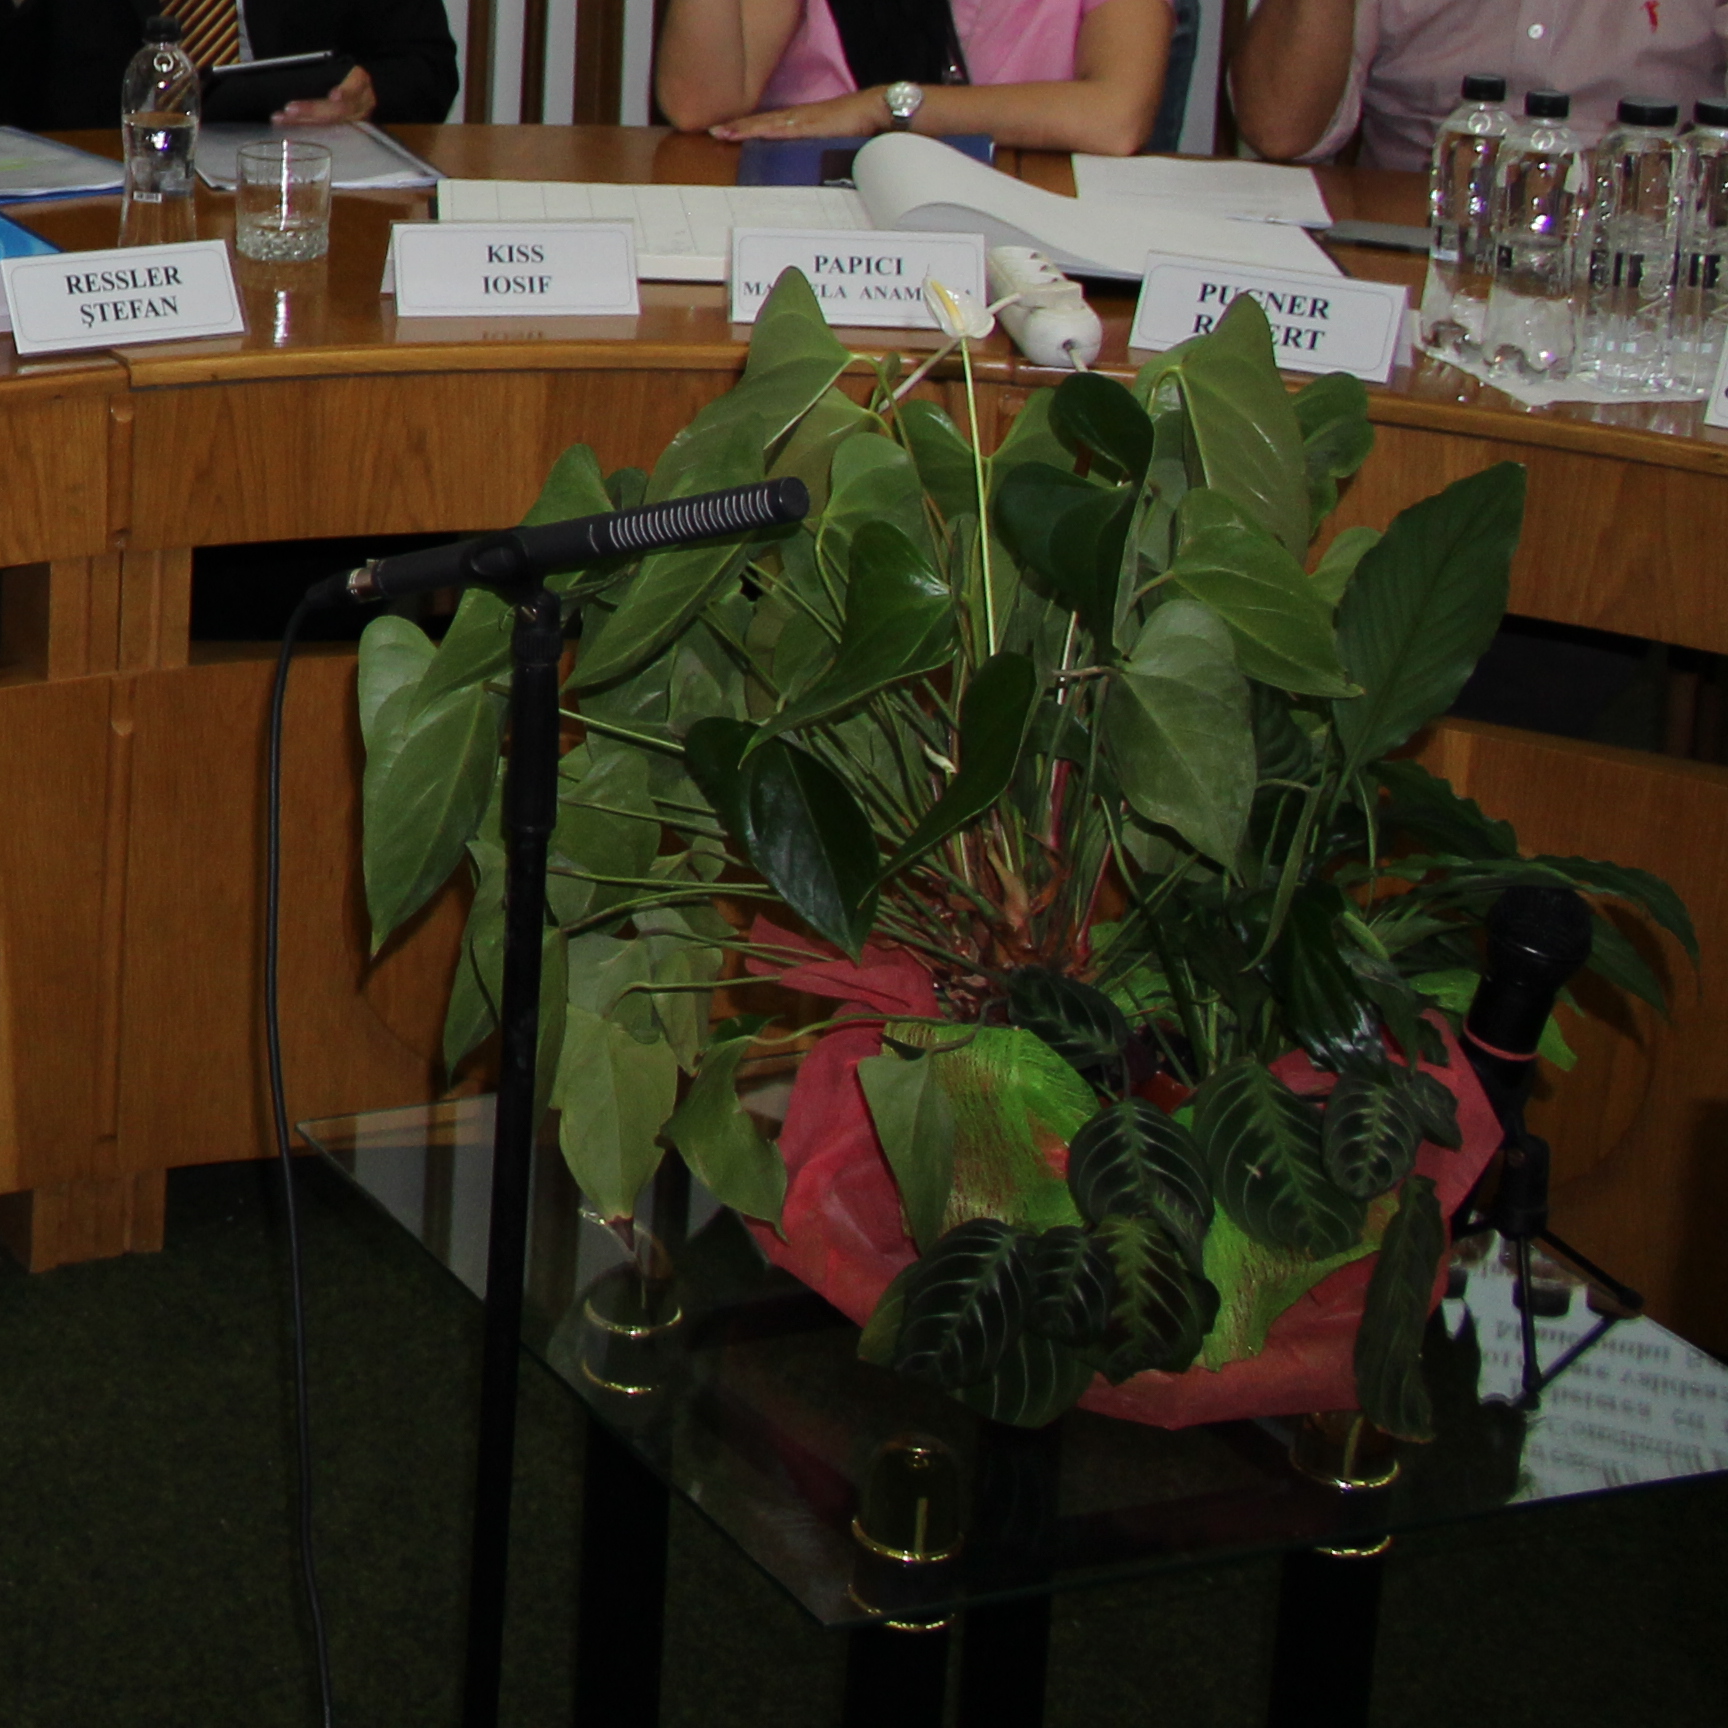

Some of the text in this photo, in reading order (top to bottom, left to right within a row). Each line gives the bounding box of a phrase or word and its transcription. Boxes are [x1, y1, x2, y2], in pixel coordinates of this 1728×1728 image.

[487, 244, 544, 264] KISS
[814, 255, 904, 276] PAPICI
[65, 265, 183, 296] RESSLER
[483, 275, 552, 295] IOSIF
